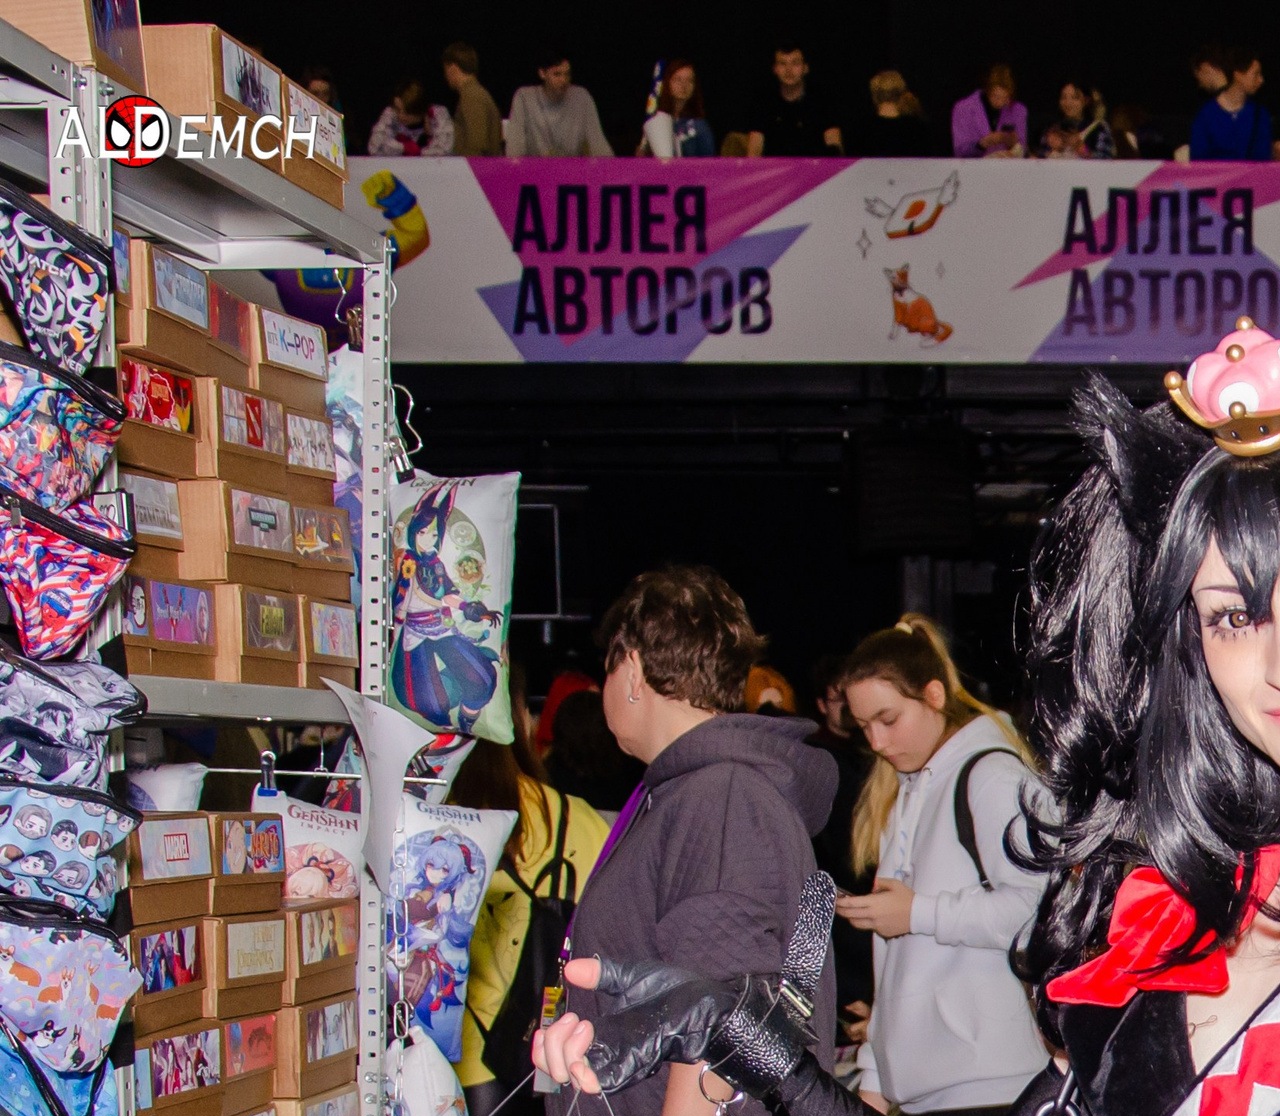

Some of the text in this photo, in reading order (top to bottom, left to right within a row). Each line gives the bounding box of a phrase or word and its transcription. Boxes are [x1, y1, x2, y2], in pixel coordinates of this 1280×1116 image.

[512, 184, 708, 254] АЛЛЕЯ
[1062, 186, 1254, 255] АЛЛЕЯ
[513, 266, 772, 335] АВТОРОВ
[278, 327, 316, 361] K-POP
[287, 804, 359, 832] GENSHIN
[416, 801, 482, 824] GENSHIN
[429, 815, 470, 827] IMPACT
[301, 821, 346, 836] IMPACT
[164, 834, 189, 861] MARVEL
[252, 830, 279, 862] NARUTO
